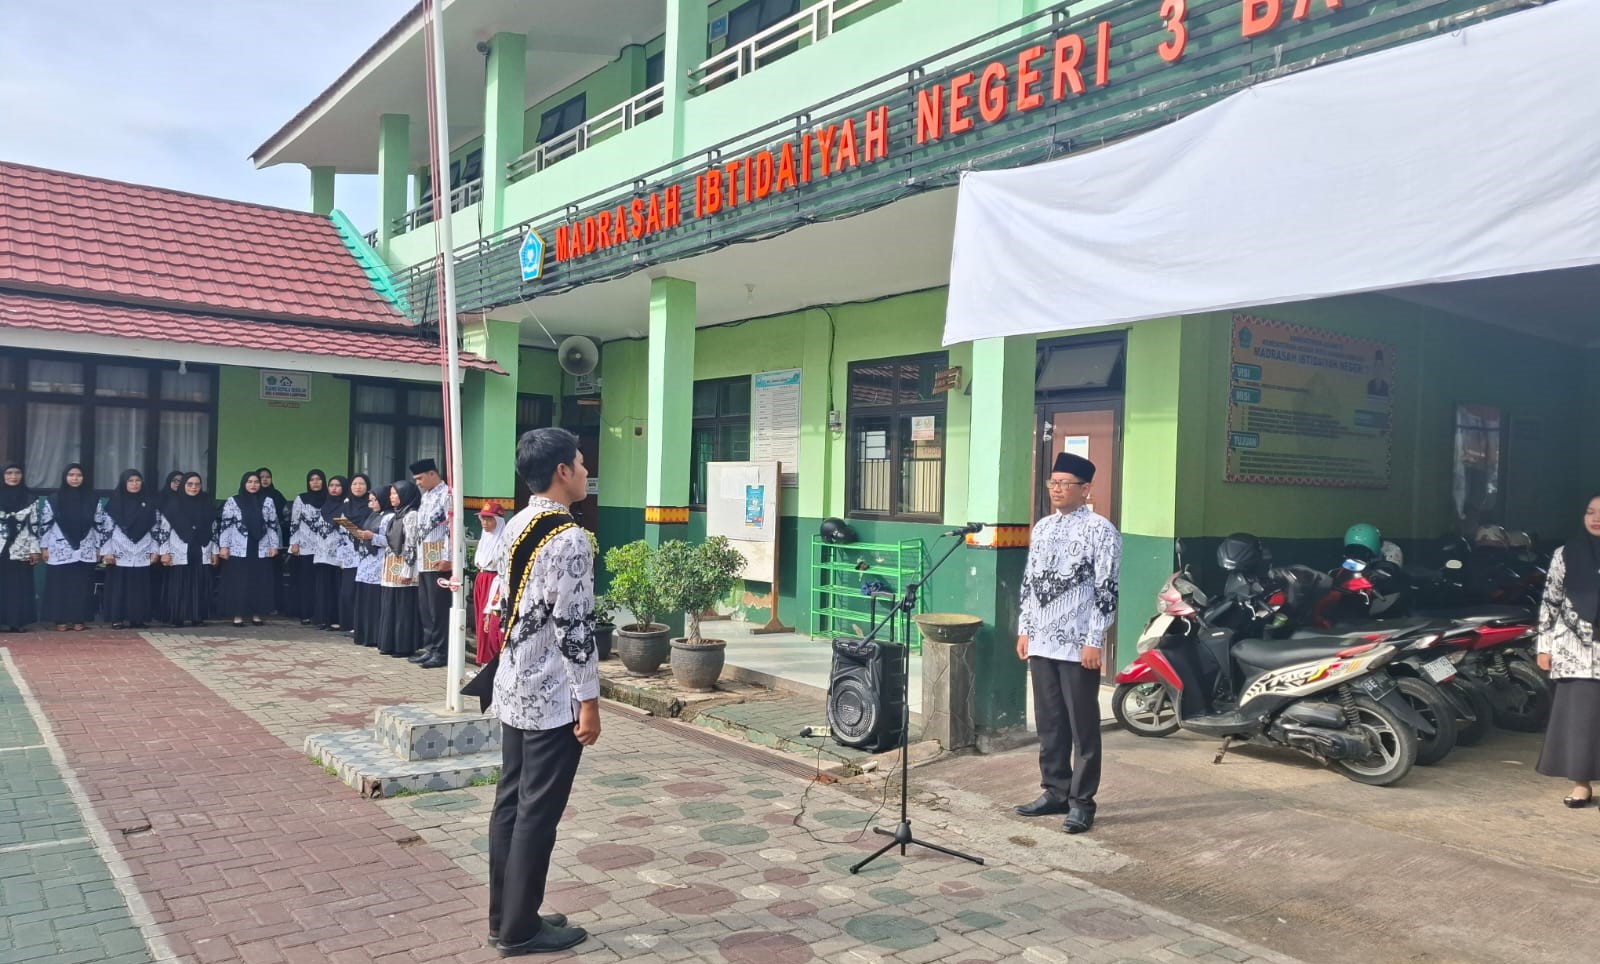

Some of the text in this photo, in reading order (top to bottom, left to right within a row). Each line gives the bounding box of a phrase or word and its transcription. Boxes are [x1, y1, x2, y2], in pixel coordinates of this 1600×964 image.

[555, 183, 681, 262] MADRASAH
[695, 105, 889, 218] IBTIDAIYAH
[917, 20, 1110, 145] NEGERI
[1158, 0, 1188, 62] 3
